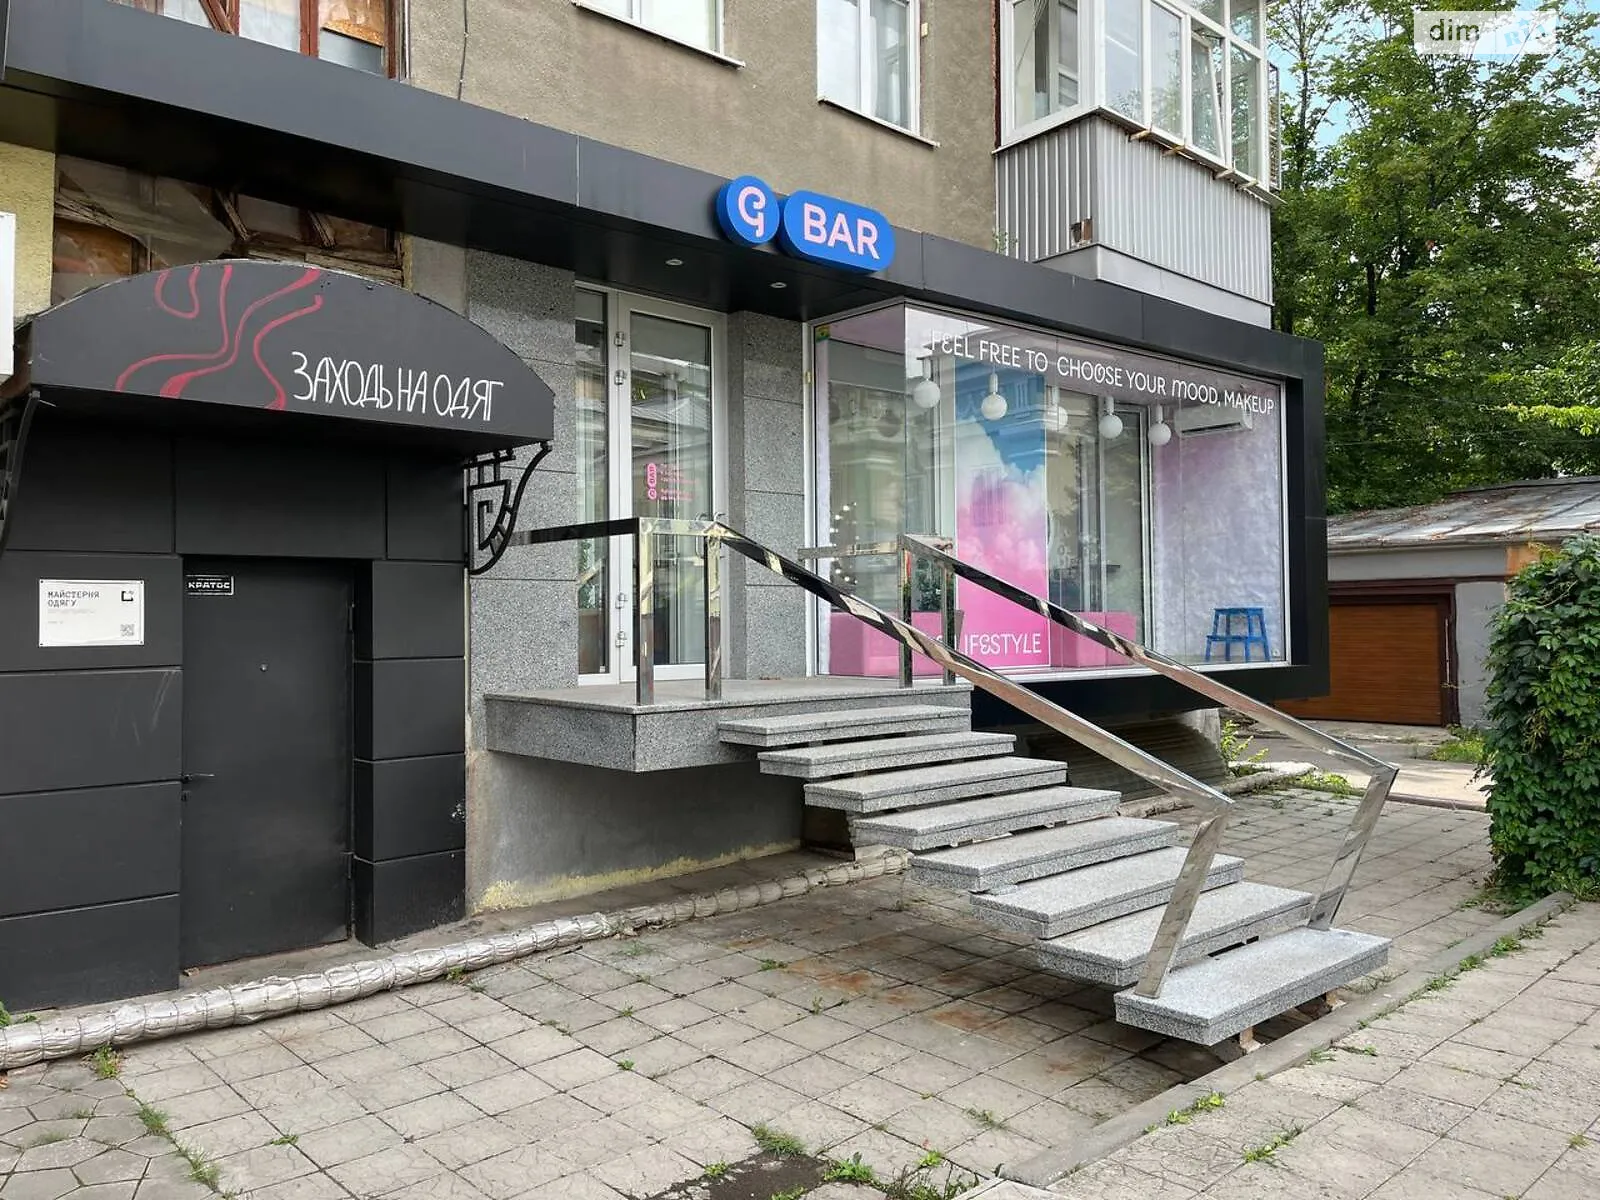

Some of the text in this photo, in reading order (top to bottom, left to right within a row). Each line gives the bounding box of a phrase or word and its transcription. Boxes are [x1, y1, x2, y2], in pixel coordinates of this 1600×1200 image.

[804, 202, 880, 260] BAR
[292, 351, 504, 422] ЗАХОДЬ НА ОДЯГ
[931, 331, 975, 359] FEEL
[979, 340, 1021, 368] FREE
[1025, 349, 1048, 372] TO
[1057, 356, 1122, 387] CHOOSE
[1125, 369, 1166, 396] YOUR
[1224, 390, 1275, 415] MAKEUP
[47, 590, 100, 599] МАЙСТЕРНЯ
[47, 599, 77, 608] ОДЯГУ
